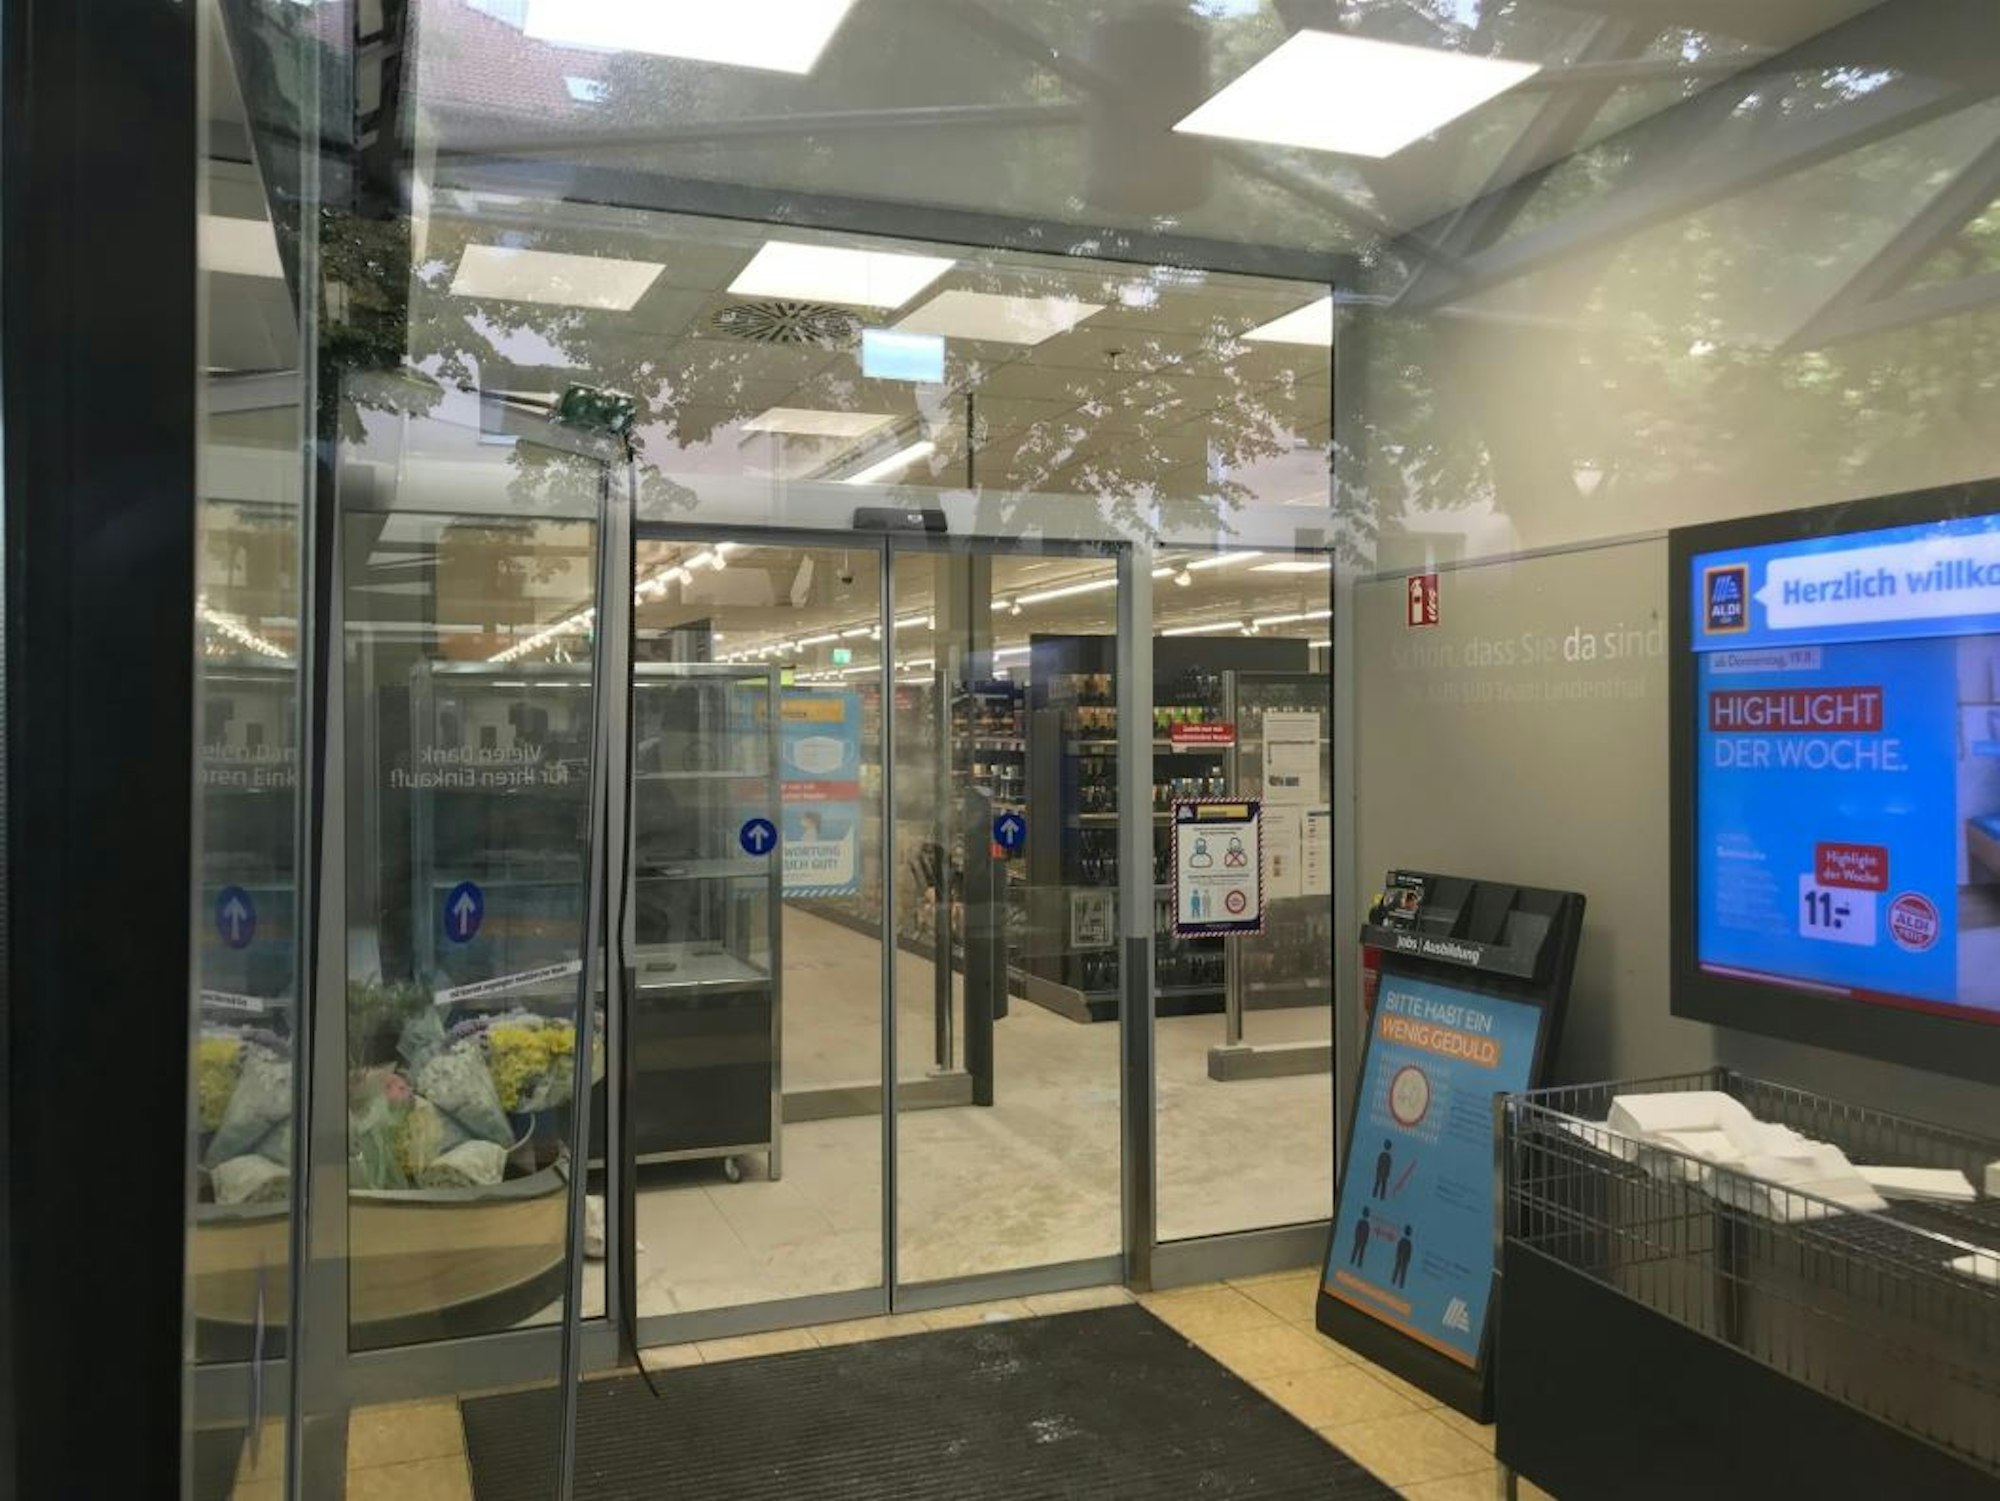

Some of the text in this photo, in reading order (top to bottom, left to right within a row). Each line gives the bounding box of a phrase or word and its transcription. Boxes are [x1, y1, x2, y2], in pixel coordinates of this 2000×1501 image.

[1783, 569, 1895, 605] Herzlich
[1712, 602, 1741, 617] ALDI
[1463, 635, 1515, 667] dass
[1521, 632, 1557, 664] Sie
[1563, 625, 1597, 662] da
[1714, 694, 1878, 726] HIGHLIGHT
[1715, 739, 1909, 771] DER WOCHE.
[1826, 849, 1878, 871] Highlight
[1844, 869, 1879, 884] Woche
[1397, 935, 1480, 966] Jobs Ausbildung
[1385, 990, 1493, 1032] BITTE HABT EIN
[1383, 1016, 1496, 1062] WENIG GEDULD
